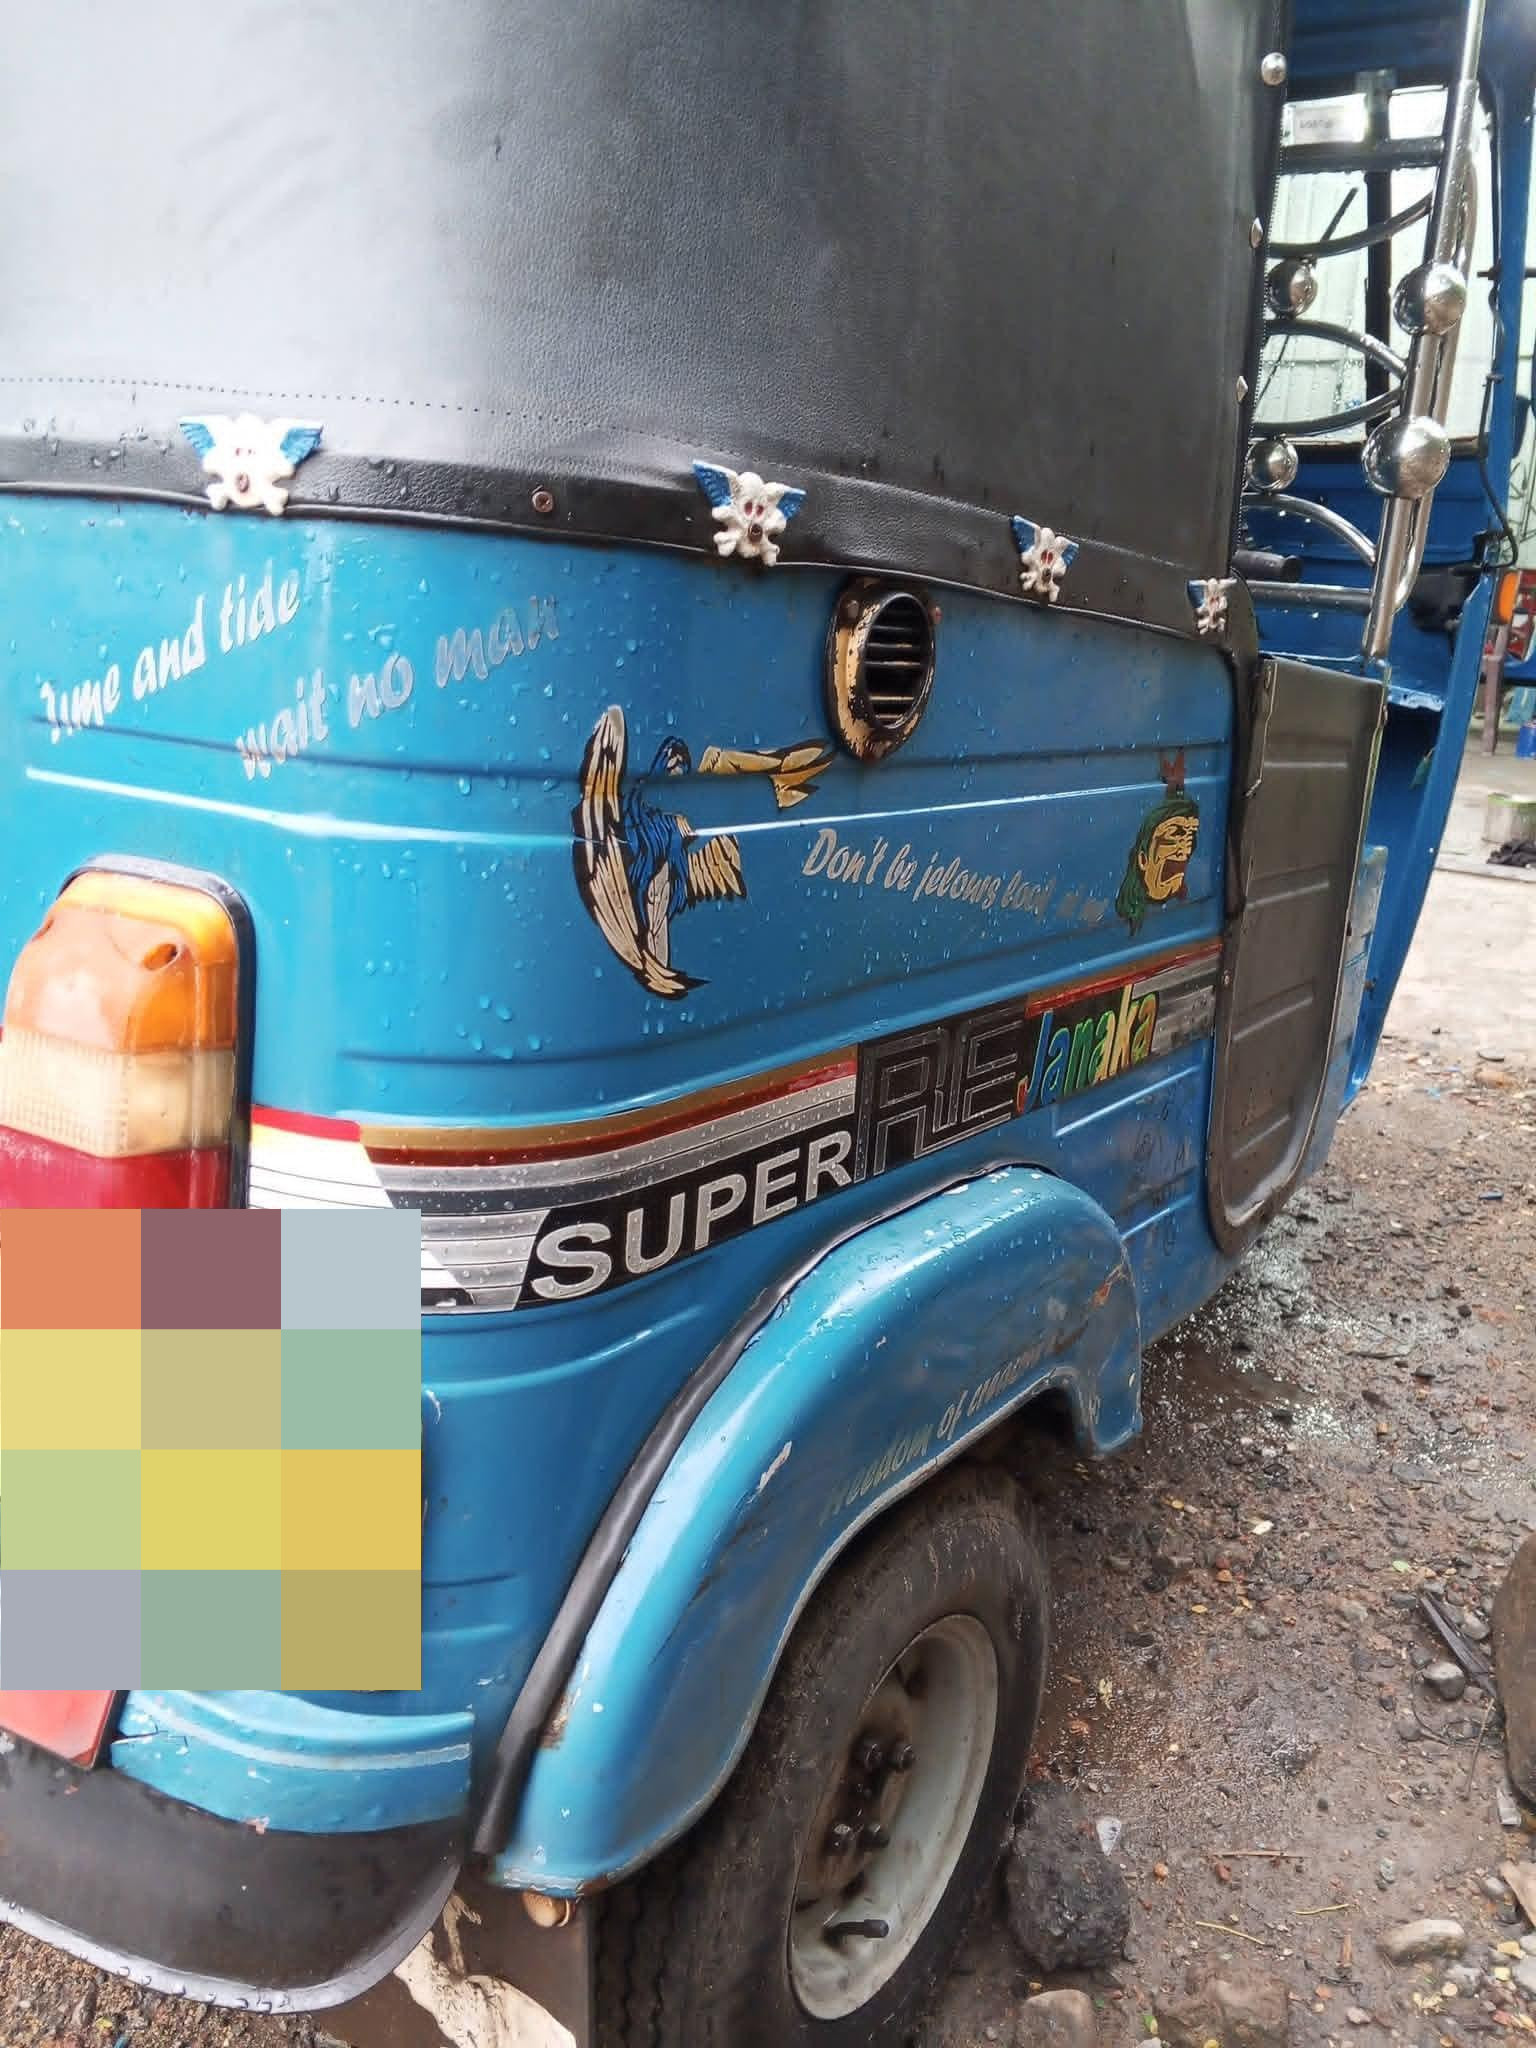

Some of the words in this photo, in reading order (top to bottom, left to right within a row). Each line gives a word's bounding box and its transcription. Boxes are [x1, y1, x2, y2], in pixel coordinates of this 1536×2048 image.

[132, 592, 207, 702] and
[218, 557, 301, 656] tide
[236, 666, 330, 781] wait
[347, 653, 415, 729] no
[802, 828, 889, 886] Don't
[883, 843, 919, 893] be
[1016, 983, 1157, 1114] Janaka
[529, 1129, 853, 1301] SUPER
[854, 1006, 1024, 1184] RE
